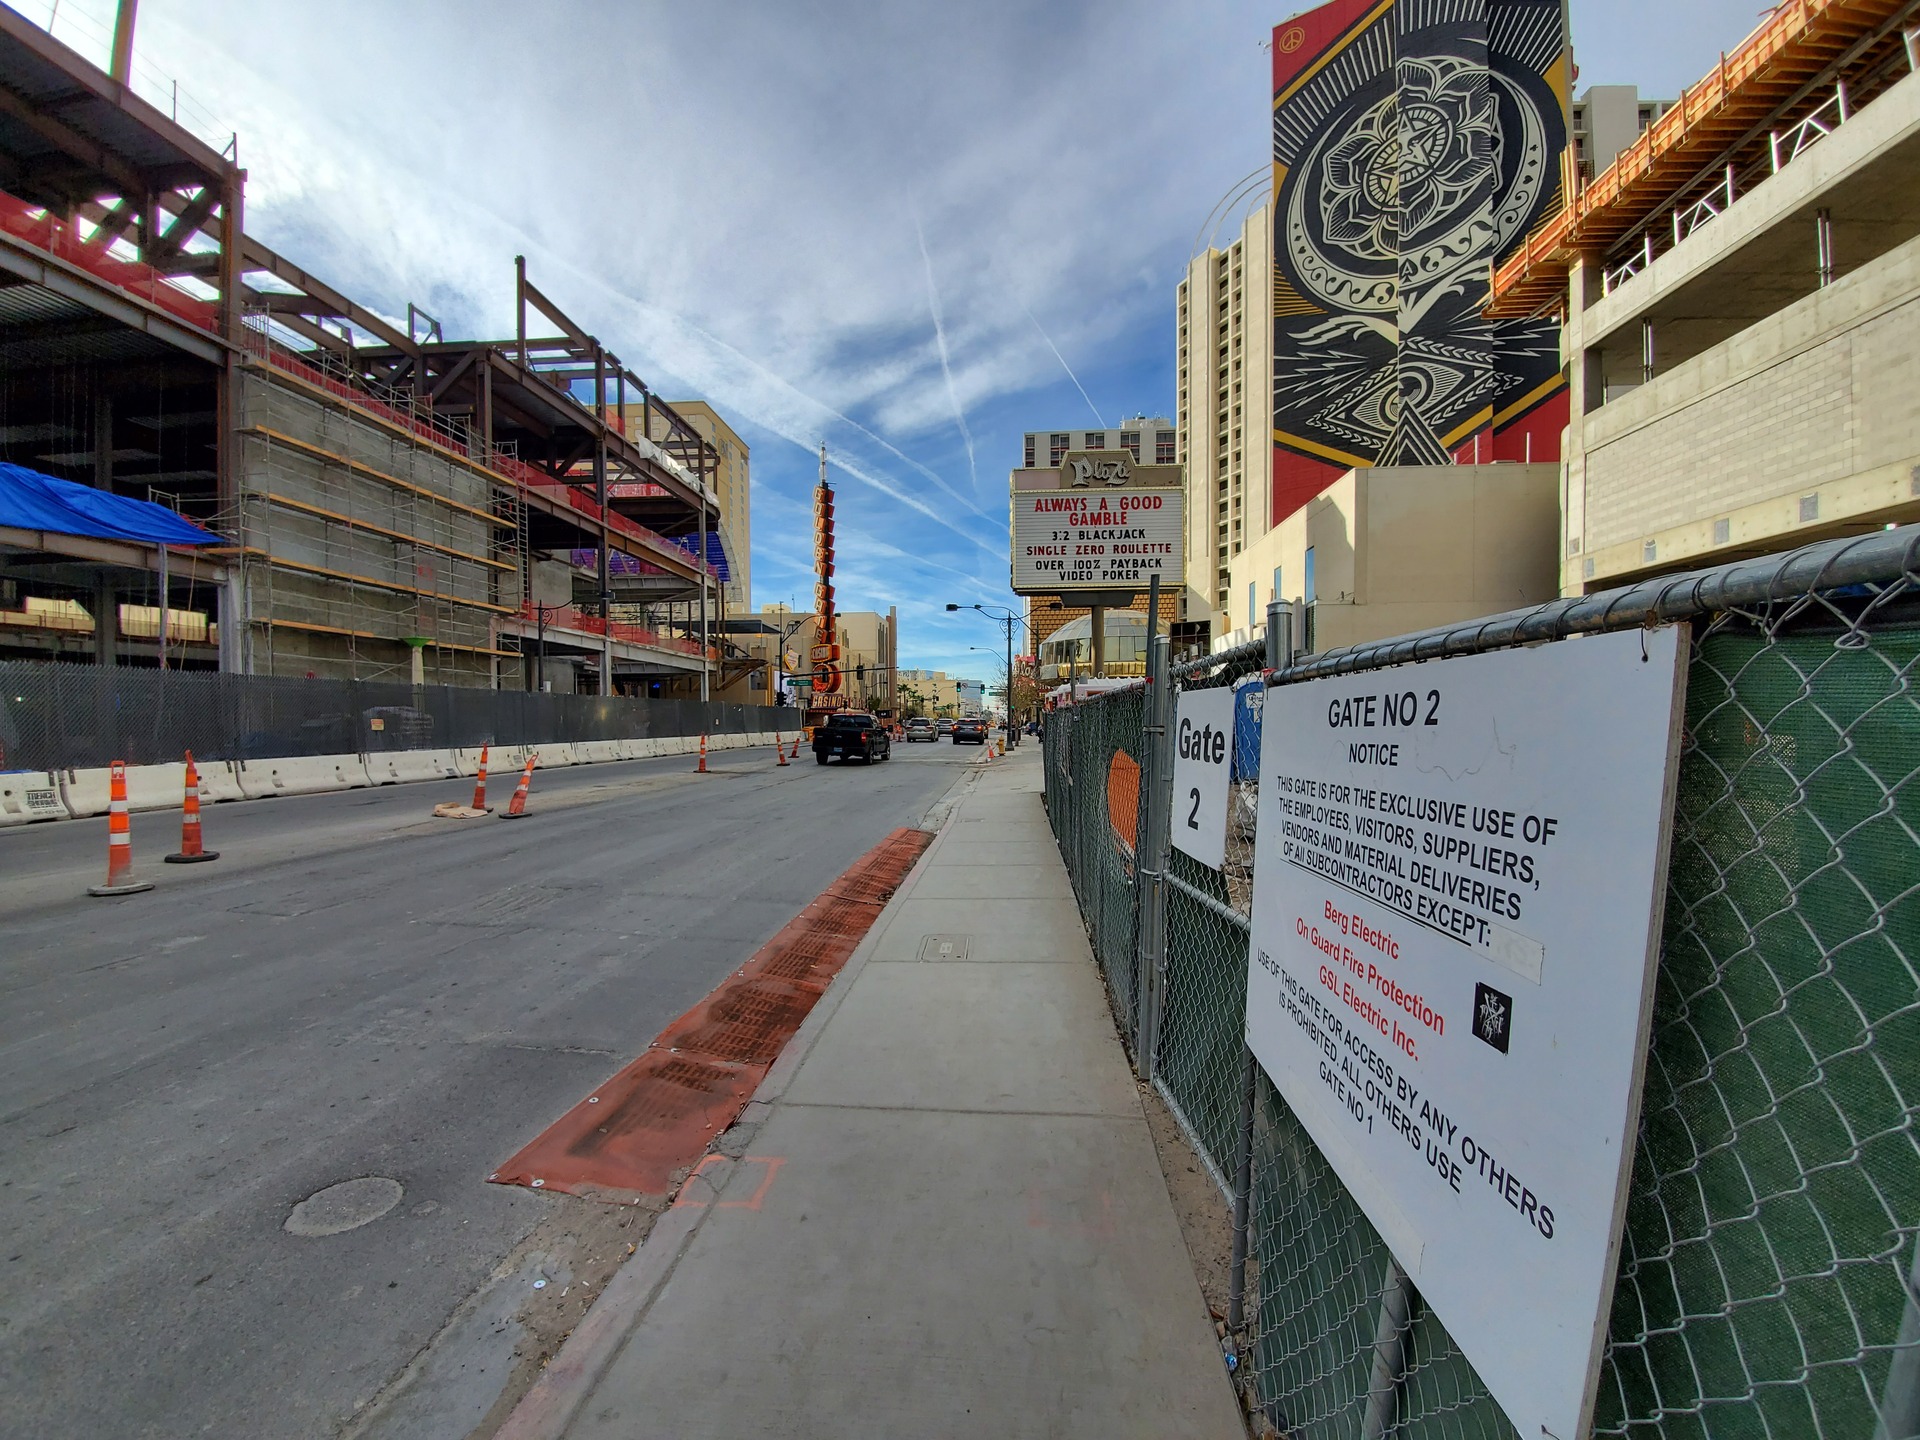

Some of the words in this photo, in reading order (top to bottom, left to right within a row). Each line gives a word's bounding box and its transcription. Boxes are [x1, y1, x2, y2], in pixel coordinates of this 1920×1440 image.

[813, 485, 827, 577] GOLDEN
[1034, 498, 1087, 512] ALWAYS
[1099, 497, 1108, 511] A
[1120, 496, 1163, 510] GOOD
[1069, 512, 1128, 526] GAMBLE
[1026, 546, 1067, 556] SINGLE
[1075, 545, 1105, 555] ZERO
[1113, 543, 1172, 554] ROULETTE
[1035, 560, 1064, 570] OVER
[1073, 559, 1101, 570] 100%
[1110, 558, 1162, 569] PAYBACK
[1052, 530, 1070, 541] 3:2
[1078, 529, 1146, 540] BLACKJACK
[1059, 570, 1093, 581] VIDEO
[1102, 570, 1140, 580] POKER
[814, 581, 827, 643] GATE
[812, 696, 842, 707] CASINO
[1328, 696, 1377, 728] GATE
[1383, 691, 1418, 727] NO
[1424, 689, 1441, 726] 2
[1179, 718, 1225, 764] Gate
[1349, 743, 1399, 766] NOTICE
[1188, 788, 1199, 830] 2
[1277, 775, 1293, 793] THIS
[1294, 778, 1317, 797] GATE
[1318, 782, 1327, 799] IS
[1329, 784, 1351, 804] FOR
[1353, 787, 1377, 810] THE
[1379, 792, 1467, 829] EXCLUSIVE
[1472, 806, 1516, 839] USE
[1522, 815, 1558, 846] OF
[1279, 797, 1293, 815] THE
[1294, 801, 1352, 835] EMPLOYEES,
[1355, 815, 1418, 855] VISITORS,
[1422, 832, 1541, 892] SUPPLIERS,
[1281, 819, 1320, 847] VENDORS
[1321, 833, 1343, 855] AND
[1344, 839, 1406, 880] MATERIAL
[1410, 860, 1522, 921] DELIVERIES
[1283, 841, 1294, 857] OF
[1306, 849, 1413, 911] SUBCONTRACTORS
[1417, 894, 1492, 947] EXCEPT:
[1324, 899, 1349, 935] Berg
[1351, 914, 1400, 960] Electric
[1296, 917, 1309, 940] On
[1310, 927, 1341, 962] Guard
[1342, 947, 1364, 979] Fire
[1367, 963, 1445, 1036] Protection
[1319, 965, 1341, 998] GSL
[1342, 982, 1389, 1036] Electric
[1392, 1020, 1420, 1062] Inc.
[1257, 947, 1270, 971] USE
[1270, 960, 1280, 978] OF
[1281, 969, 1297, 997] THIS
[1298, 986, 1321, 1020] GATE
[1322, 1007, 1343, 1041] FOR
[1344, 1029, 1394, 1088] ACCESS
[1397, 1075, 1419, 1110] BY
[1419, 1099, 1458, 1146] ANY
[1461, 1136, 1555, 1240] OTHERS
[1278, 990, 1286, 1009] IS
[1286, 998, 1340, 1067] PROHIBITED.
[1341, 1055, 1363, 1091] ALL
[1365, 1079, 1422, 1151] OTHERS
[1426, 1138, 1463, 1194] USE
[1319, 1061, 1345, 1103] GATE
[1347, 1090, 1365, 1123] NO
[1367, 1115, 1374, 1134] 1
